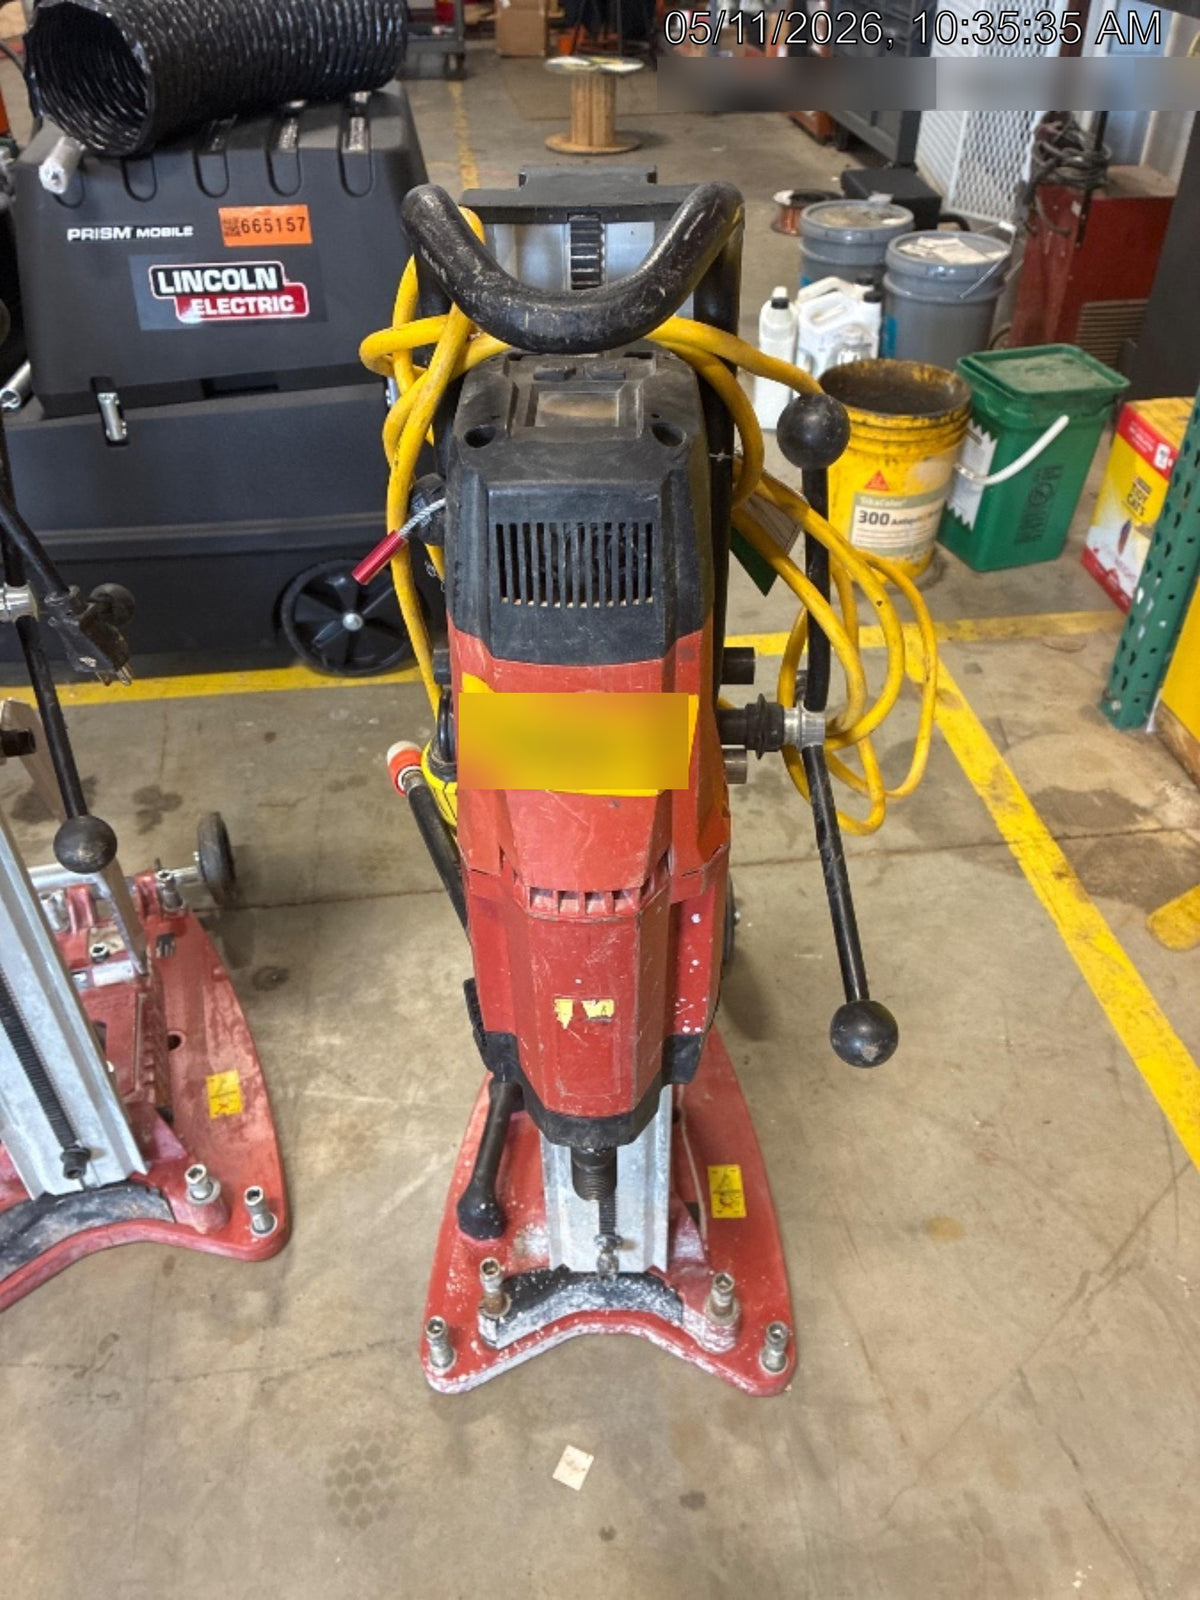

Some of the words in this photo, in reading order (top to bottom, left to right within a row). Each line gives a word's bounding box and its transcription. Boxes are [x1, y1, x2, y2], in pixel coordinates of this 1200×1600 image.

[67, 227, 132, 241] PRISM
[136, 226, 194, 239] MOBILE
[241, 216, 306, 234] 665157
[157, 266, 278, 295] LINCOLN
[191, 295, 295, 316] ELECTRIC
[858, 510, 890, 526] 300
